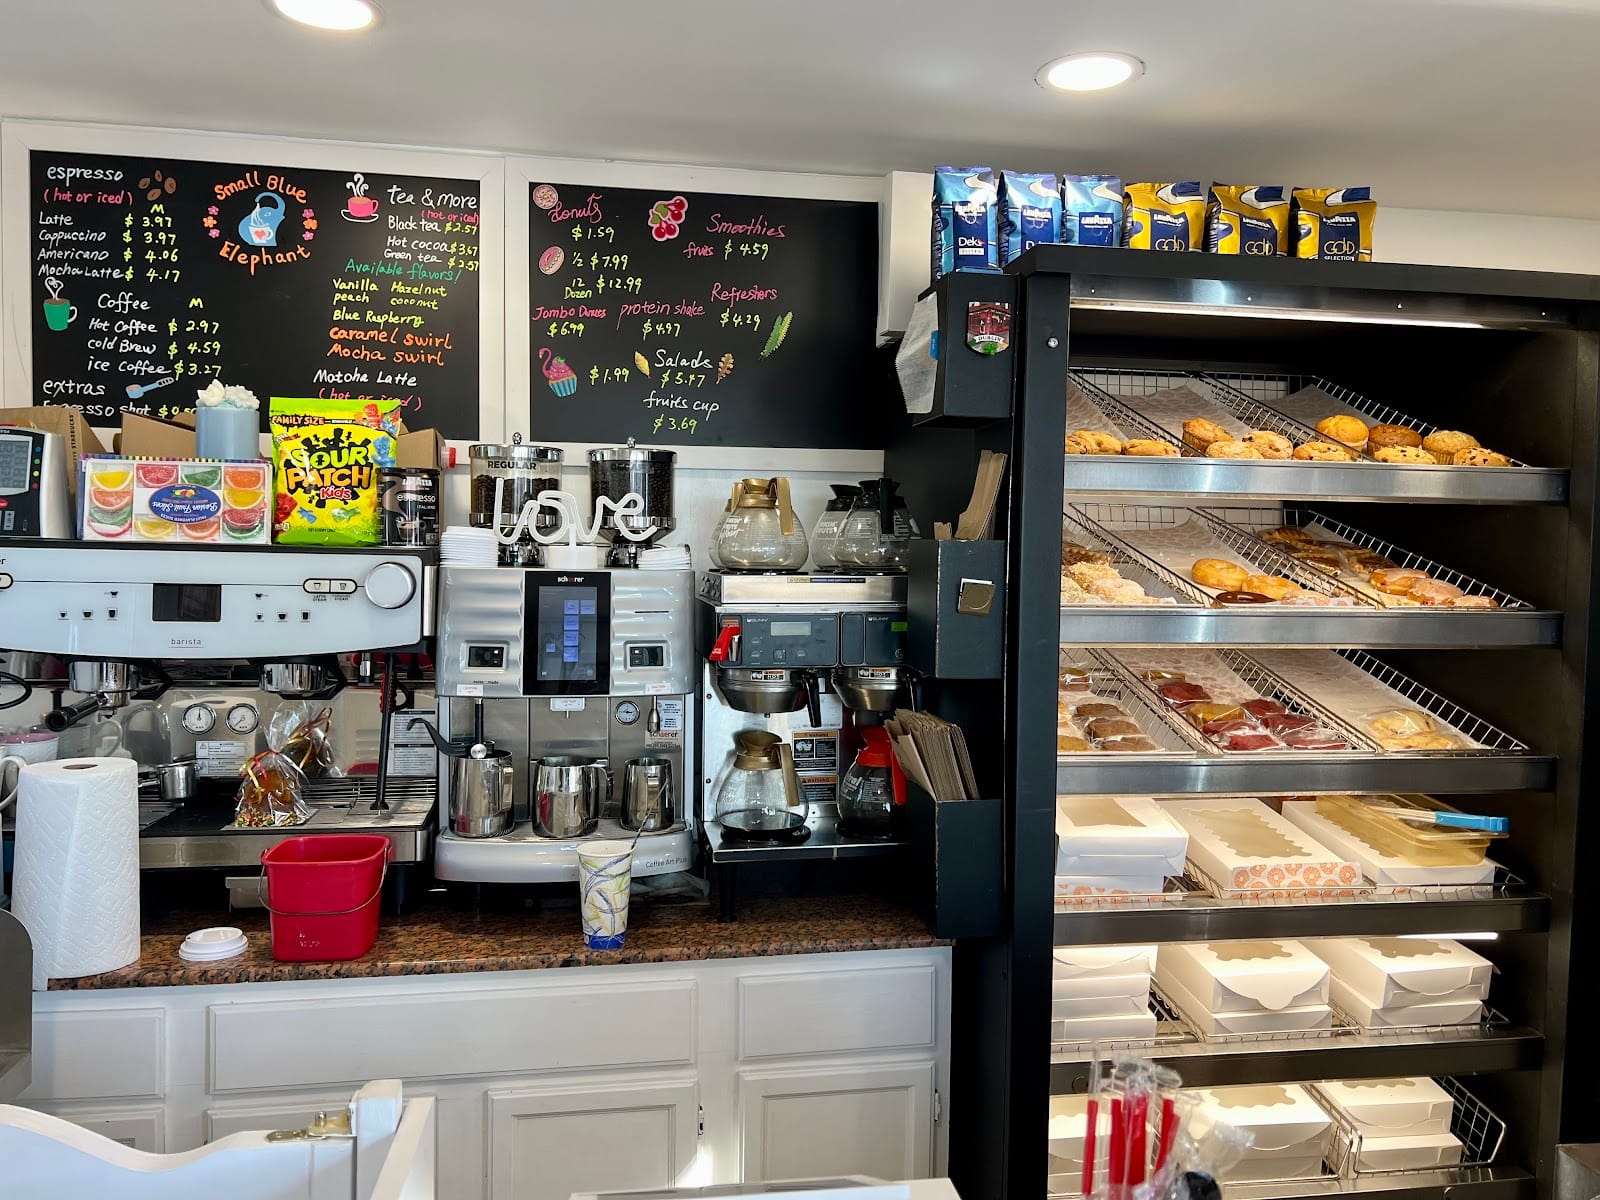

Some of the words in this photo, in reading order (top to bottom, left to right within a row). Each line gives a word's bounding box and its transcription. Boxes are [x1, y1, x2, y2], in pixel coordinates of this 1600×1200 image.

[47, 166, 124, 186] espresso
[214, 170, 261, 200] Small
[267, 175, 307, 204] Blue
[76, 193, 90, 203] or
[387, 185, 415, 205] tea
[421, 188, 435, 209] &
[437, 194, 477, 208] more
[151, 204, 164, 214] M
[448, 213, 459, 222] or
[39, 212, 73, 225] Latte
[388, 215, 417, 231] Black
[420, 218, 441, 233] tea
[706, 213, 786, 238] Smoothies
[1081, 215, 1112, 224] LAVAZZA
[39, 230, 106, 249] Cappuccino
[387, 236, 407, 248] Hot
[411, 240, 451, 252] cocoa
[37, 249, 109, 260] Americano
[219, 241, 311, 276] Elephant
[384, 249, 411, 261] Green
[417, 253, 442, 263] tea
[344, 258, 403, 276] Available
[333, 278, 379, 291] Vanilla
[391, 282, 447, 297] Hazelnut
[572, 278, 585, 288] 12
[564, 286, 593, 299] Dozen
[711, 282, 778, 308] Refreshers
[98, 292, 150, 313] Coffee
[189, 298, 203, 308] M
[390, 297, 439, 310] coconut
[333, 307, 360, 321] Blue
[616, 301, 670, 331] protein
[674, 299, 706, 317] shake
[89, 319, 110, 331] Hot
[88, 337, 117, 350] cold
[119, 339, 157, 355] Brew
[329, 327, 398, 344] Caramel
[403, 332, 452, 350] swirl
[327, 343, 386, 361] Mocha
[393, 351, 444, 366] swirl
[654, 349, 713, 369] Salads
[88, 356, 109, 371] ice
[377, 371, 417, 387] Latte
[43, 380, 106, 397] extras
[643, 390, 688, 409] fruits
[693, 400, 719, 421] cup
[291, 446, 368, 469] SOUR
[487, 461, 537, 470] REGULAR
[286, 467, 371, 490] PATCH
[320, 486, 351, 500] Kids
